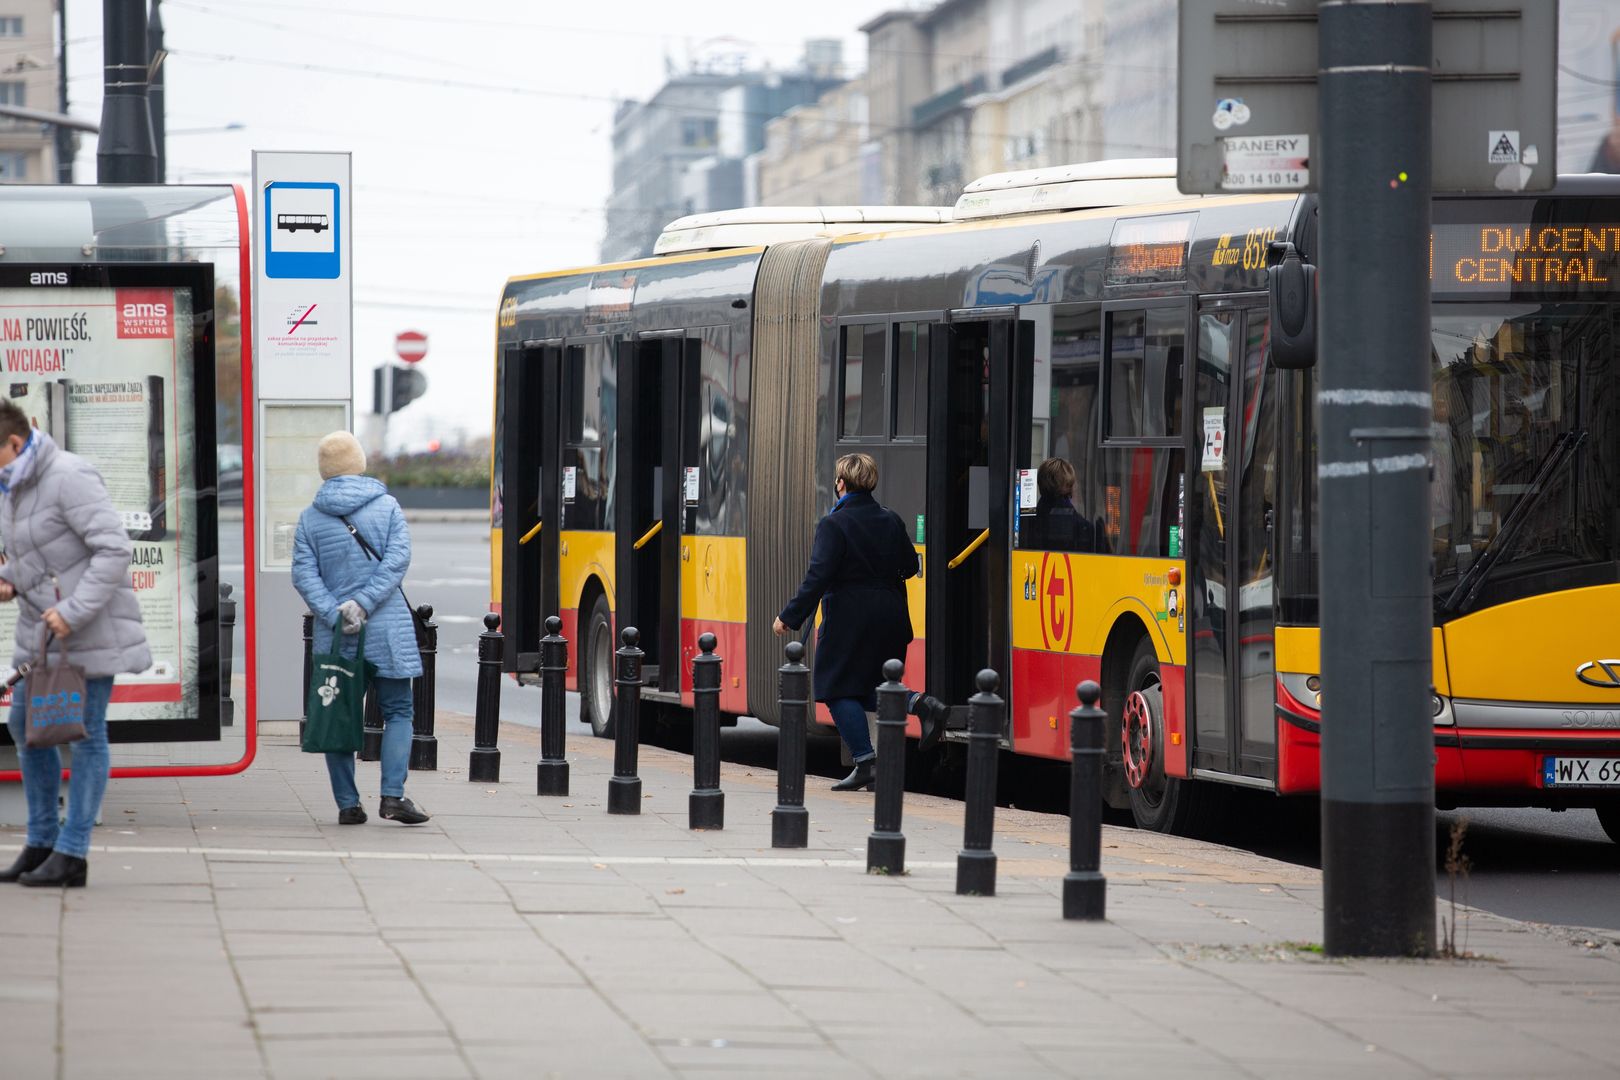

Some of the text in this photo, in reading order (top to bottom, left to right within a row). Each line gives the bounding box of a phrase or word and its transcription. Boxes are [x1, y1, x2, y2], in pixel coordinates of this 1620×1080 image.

[1225, 139, 1298, 152] BANERY
[1250, 173, 1263, 185] 14
[1268, 172, 1281, 184] 10
[1286, 172, 1299, 184] 14
[1456, 258, 1608, 282] CENTRAL
[30, 272, 68, 284] ams
[123, 304, 167, 317] ams
[26, 312, 91, 341] POWIEŚĆ,
[124, 327, 168, 335] KULTURĘ
[129, 547, 163, 568] AJĄCA
[1561, 711, 1620, 728] SOLA
[1560, 760, 1590, 781] WX
